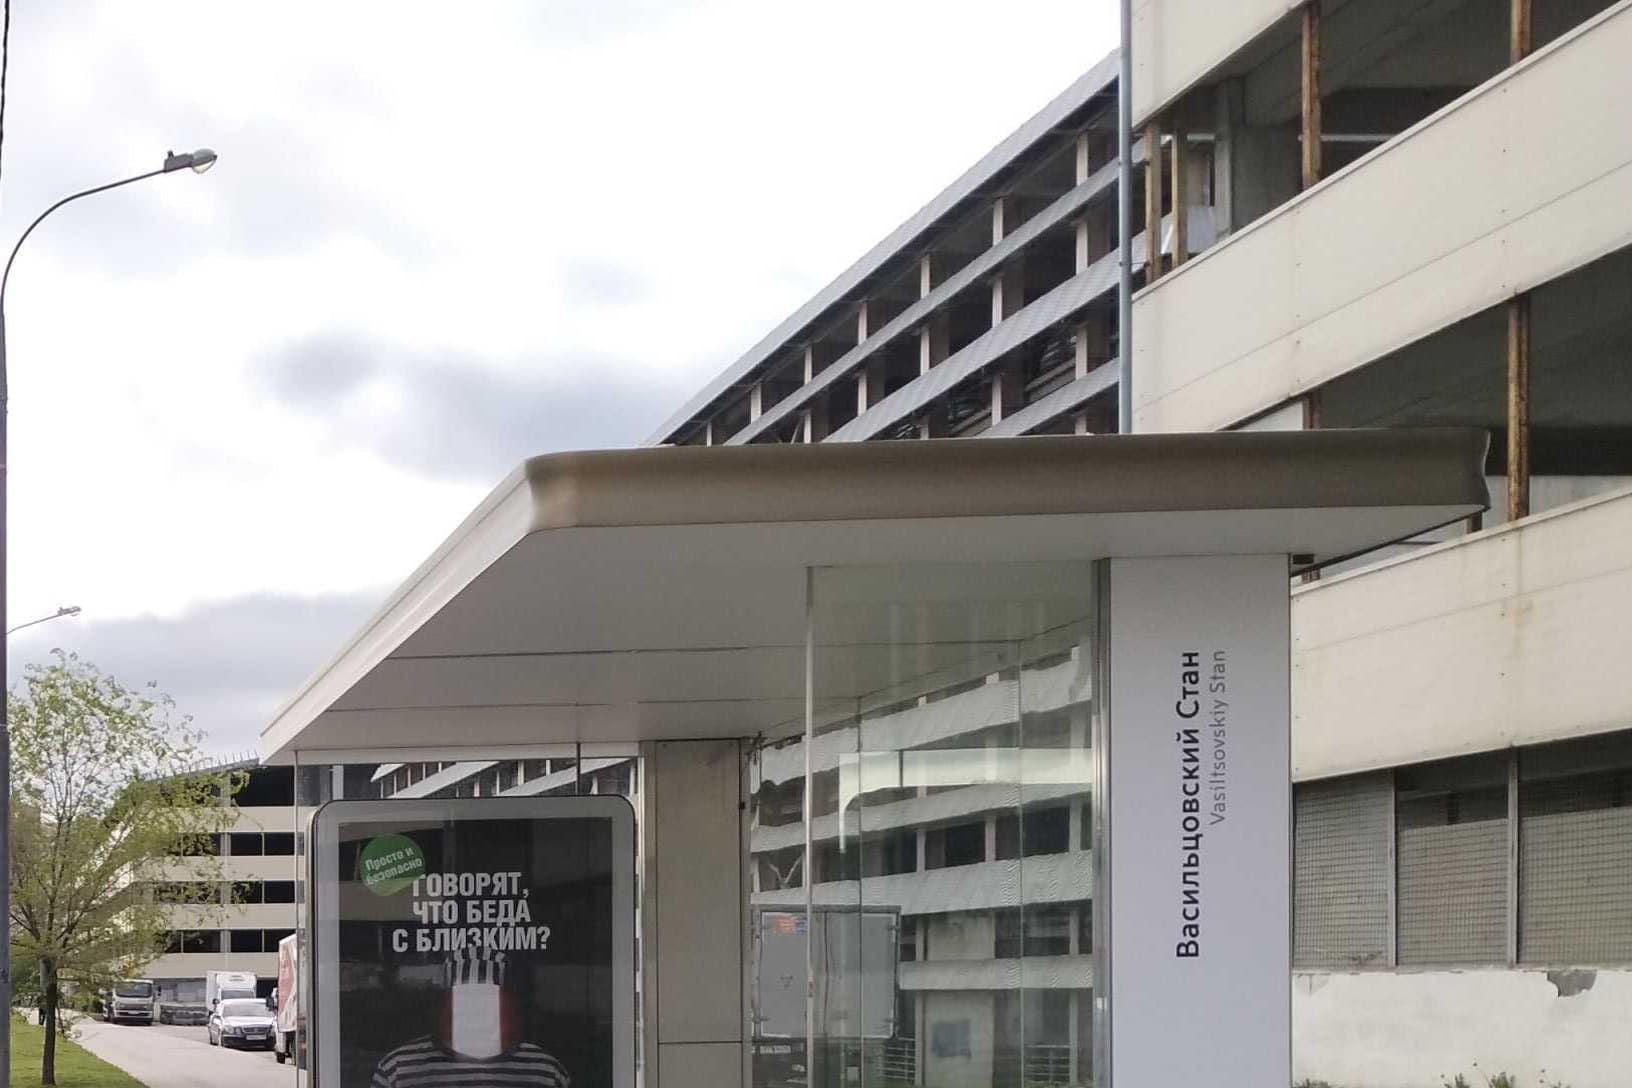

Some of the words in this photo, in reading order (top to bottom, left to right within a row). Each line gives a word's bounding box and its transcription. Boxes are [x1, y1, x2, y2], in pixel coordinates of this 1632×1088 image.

[1175, 651, 1200, 719] Стан
[1209, 650, 1226, 693] Stan
[1208, 699, 1230, 825] Vasiltsovskiy
[1175, 728, 1204, 958] Васильцовский
[412, 871, 530, 898] ГОВОРЯТ,
[412, 900, 459, 925] ЧТО
[466, 898, 532, 927] БЕДА
[392, 928, 409, 953] С
[416, 925, 551, 952] БЛИЗКИМ?
